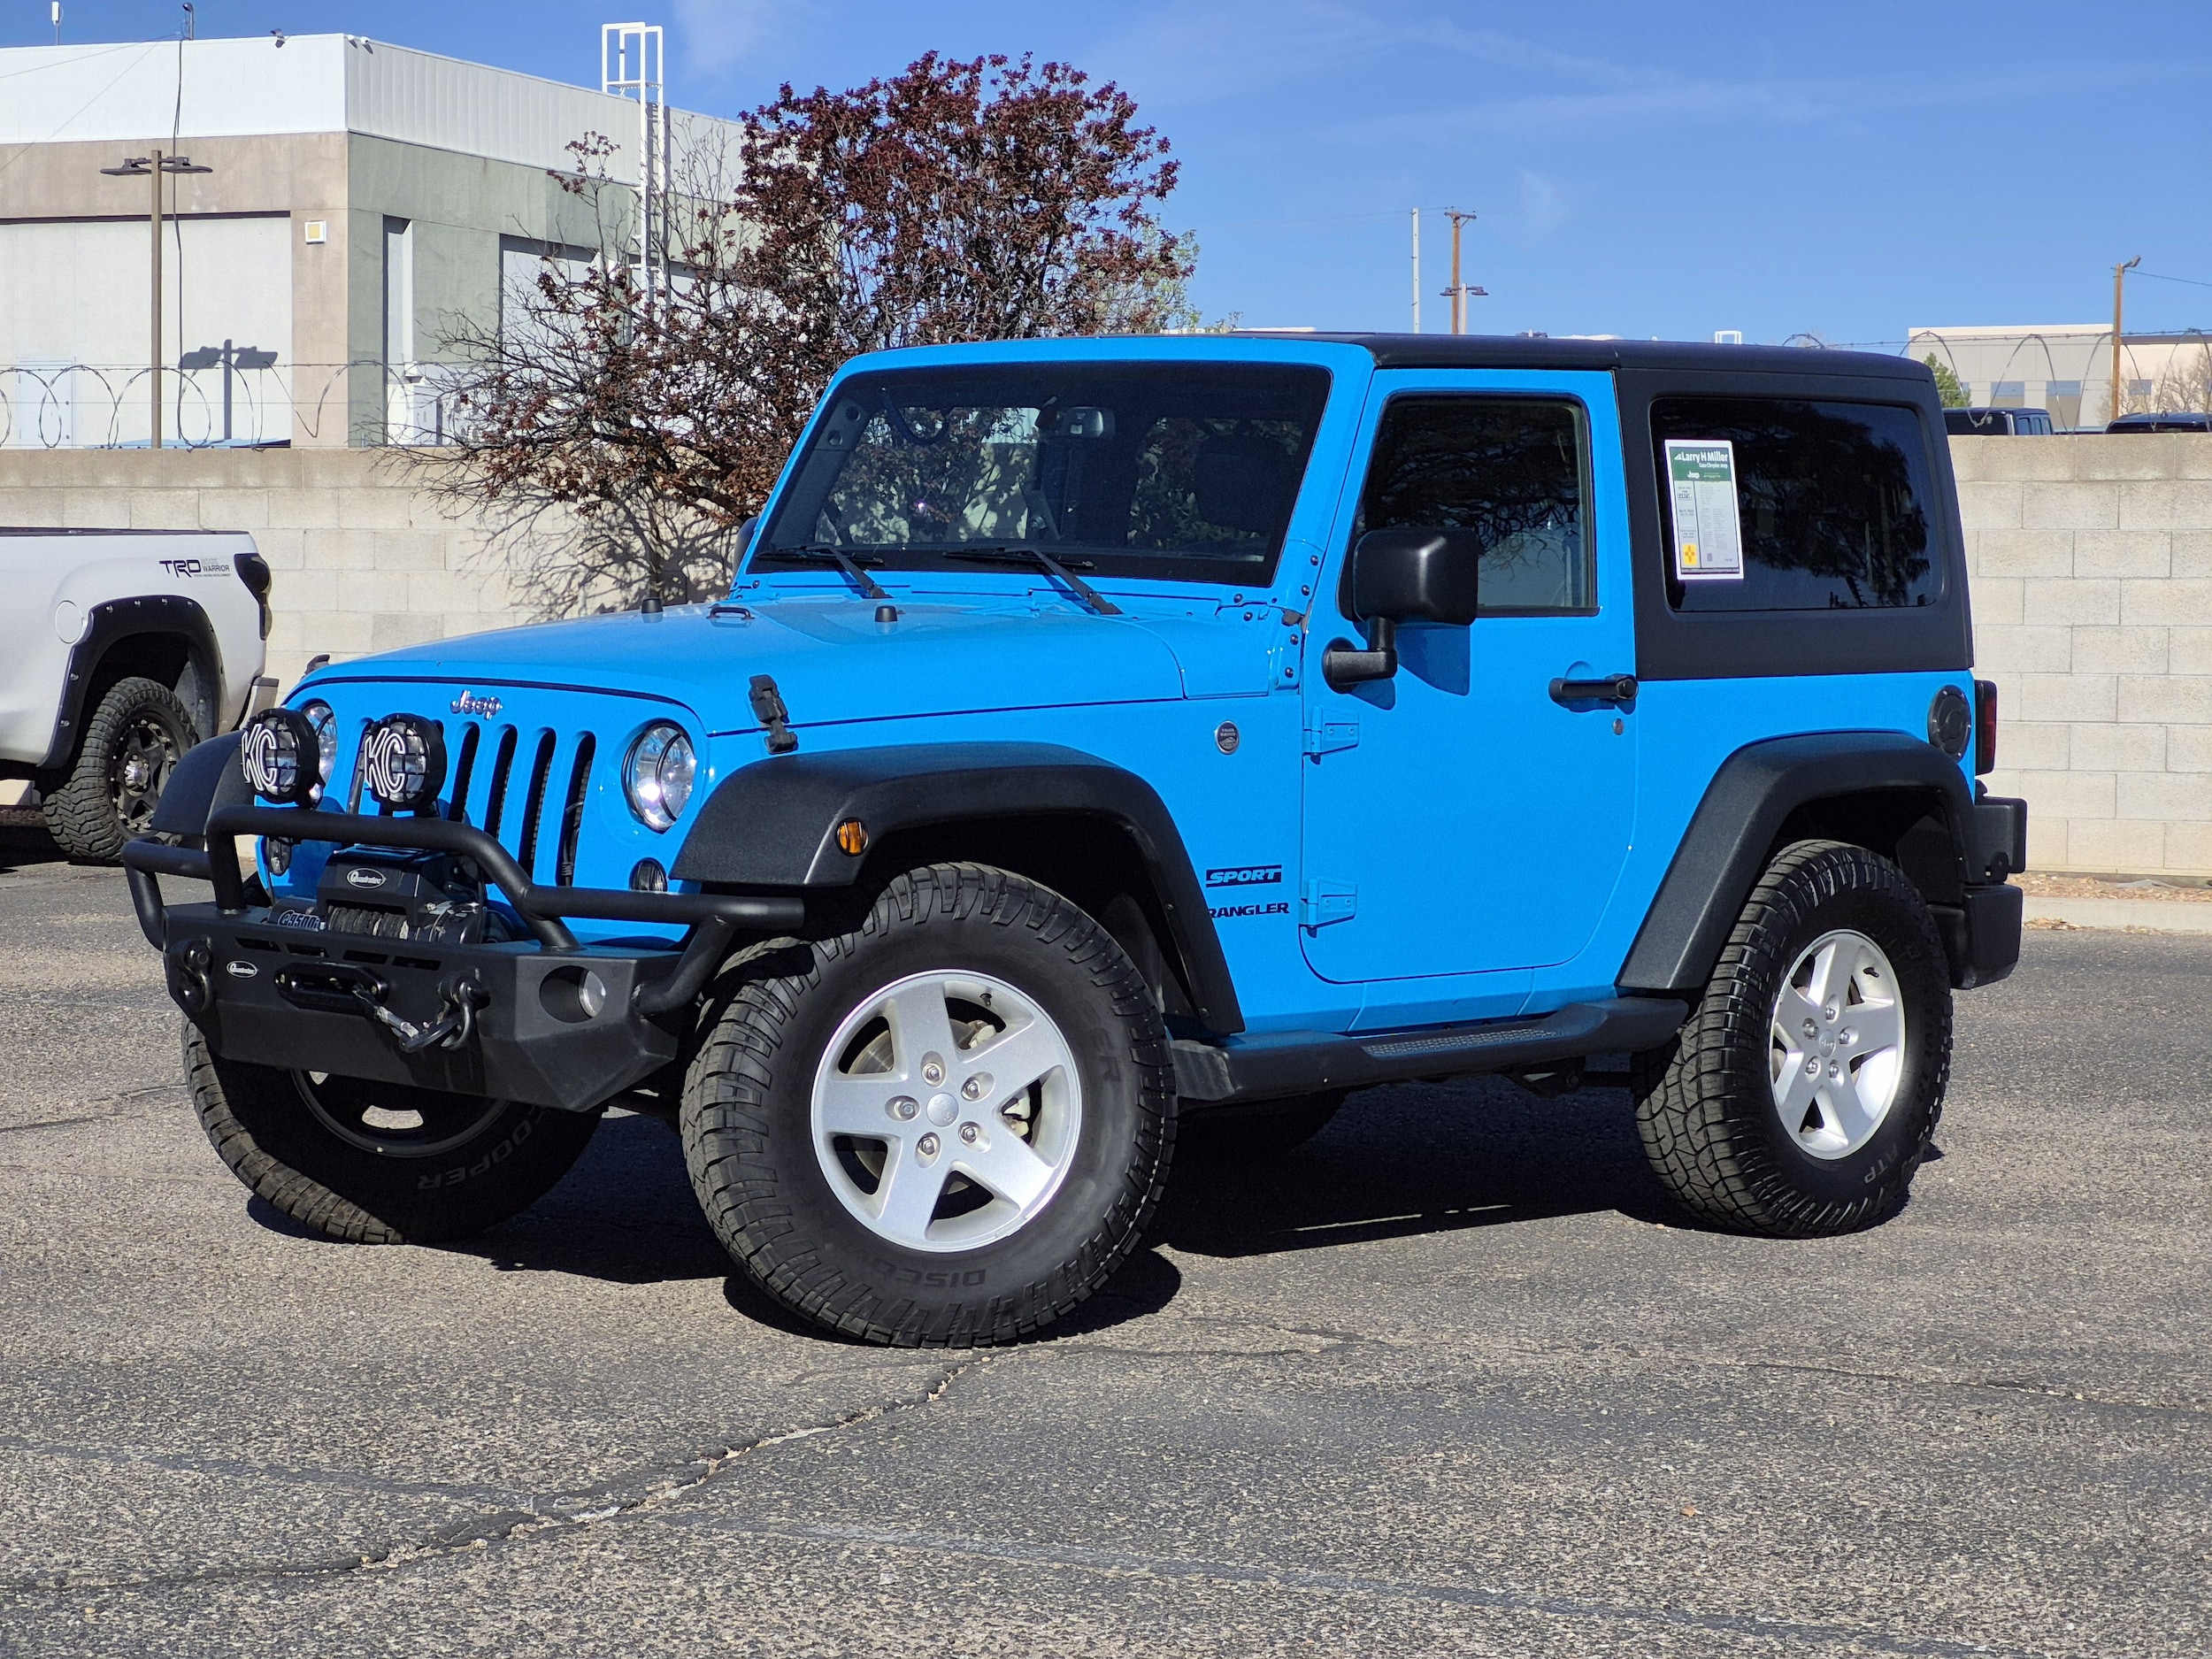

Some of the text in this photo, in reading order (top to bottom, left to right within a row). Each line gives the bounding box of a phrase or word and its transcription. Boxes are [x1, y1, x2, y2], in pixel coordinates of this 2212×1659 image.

[1681, 451, 1728, 463] Larry H Miller
[159, 559, 202, 578] TRD
[450, 690, 503, 720] Jeep
[241, 722, 278, 792] KC
[365, 727, 406, 798] KC
[1206, 868, 1282, 885] SPORT
[1208, 902, 1290, 918] RANGLER
